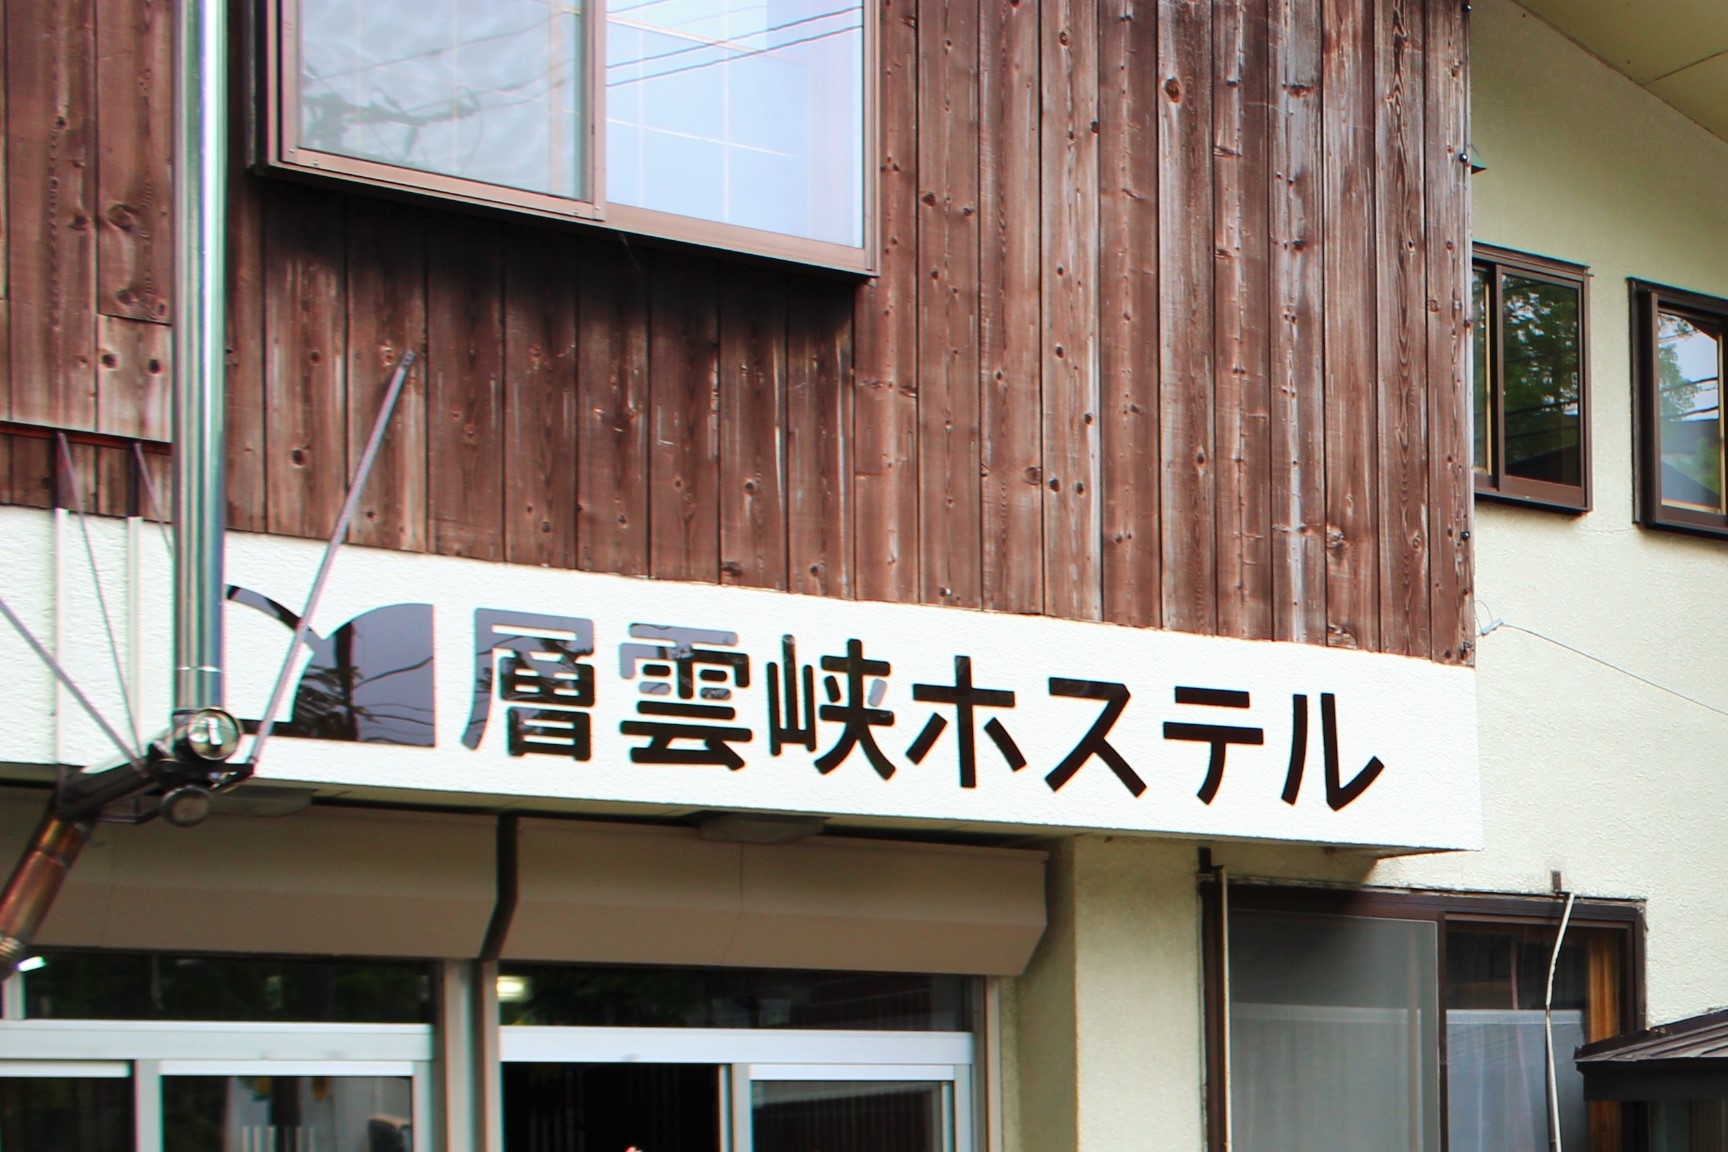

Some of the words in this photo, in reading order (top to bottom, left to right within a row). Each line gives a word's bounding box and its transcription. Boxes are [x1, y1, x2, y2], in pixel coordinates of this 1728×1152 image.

[461, 606, 1385, 812] 層雲峡ホステル
